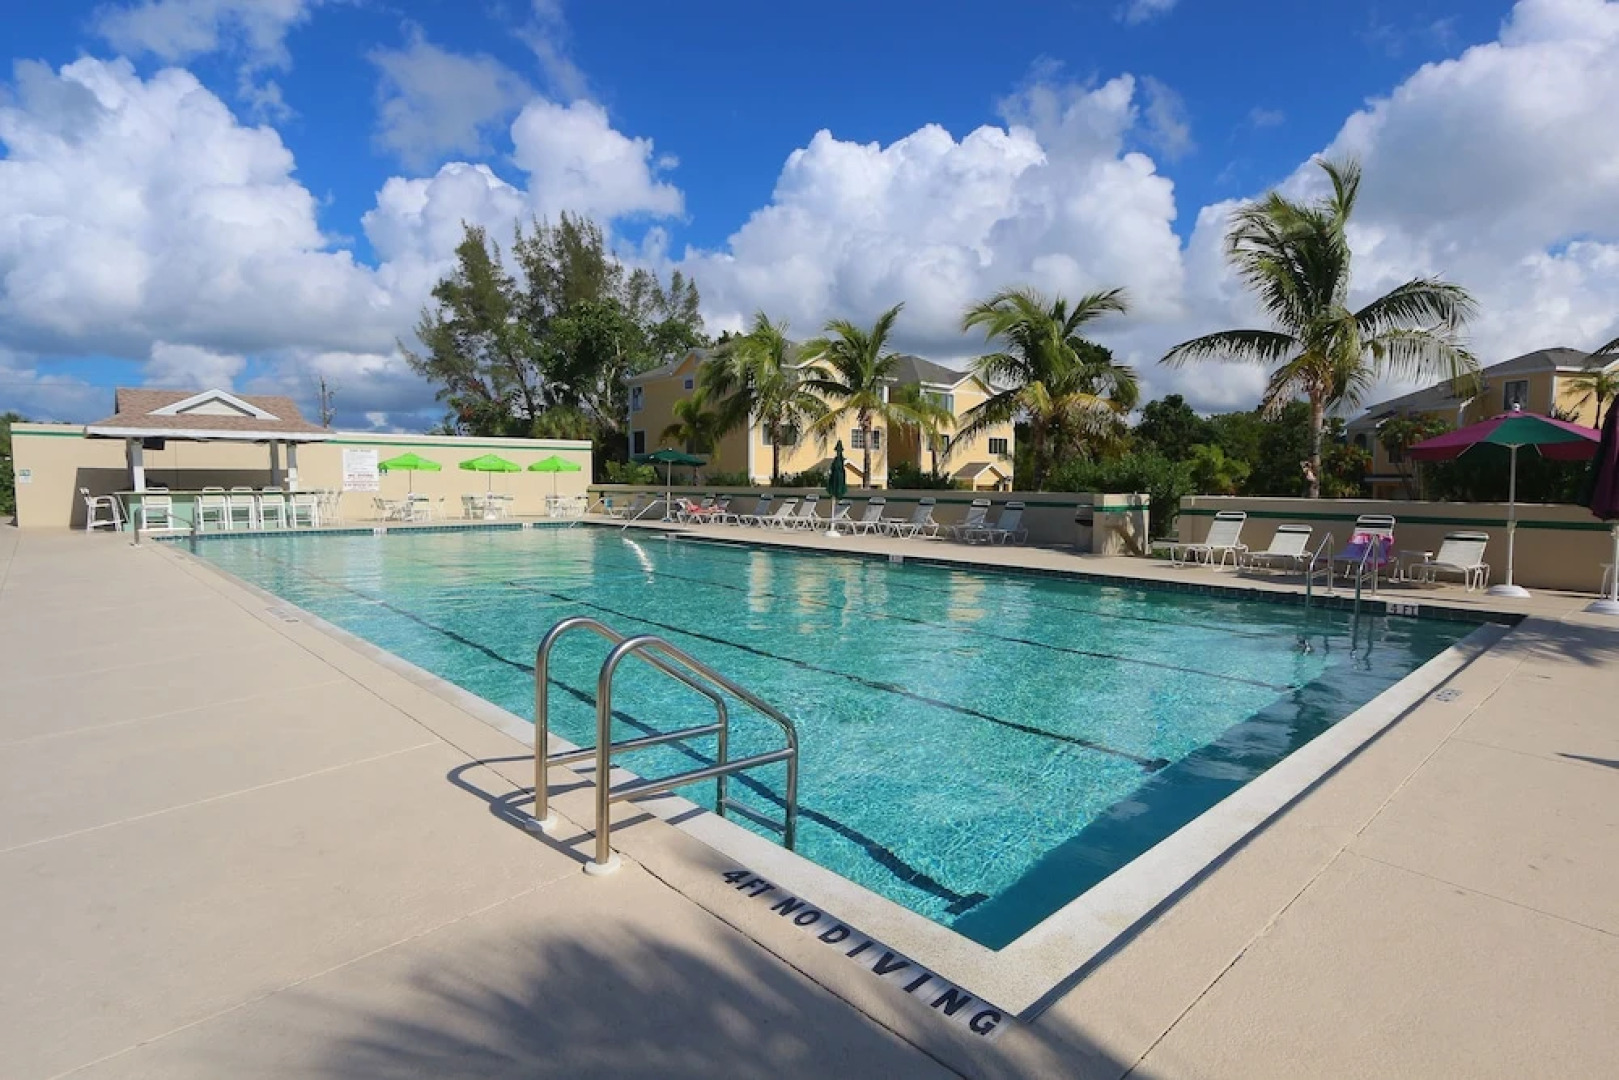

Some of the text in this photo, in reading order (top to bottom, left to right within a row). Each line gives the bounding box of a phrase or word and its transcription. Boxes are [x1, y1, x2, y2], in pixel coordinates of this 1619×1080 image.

[1403, 605, 1417, 616] FT
[770, 896, 822, 927] NO
[817, 925, 1002, 1036] DIVING
